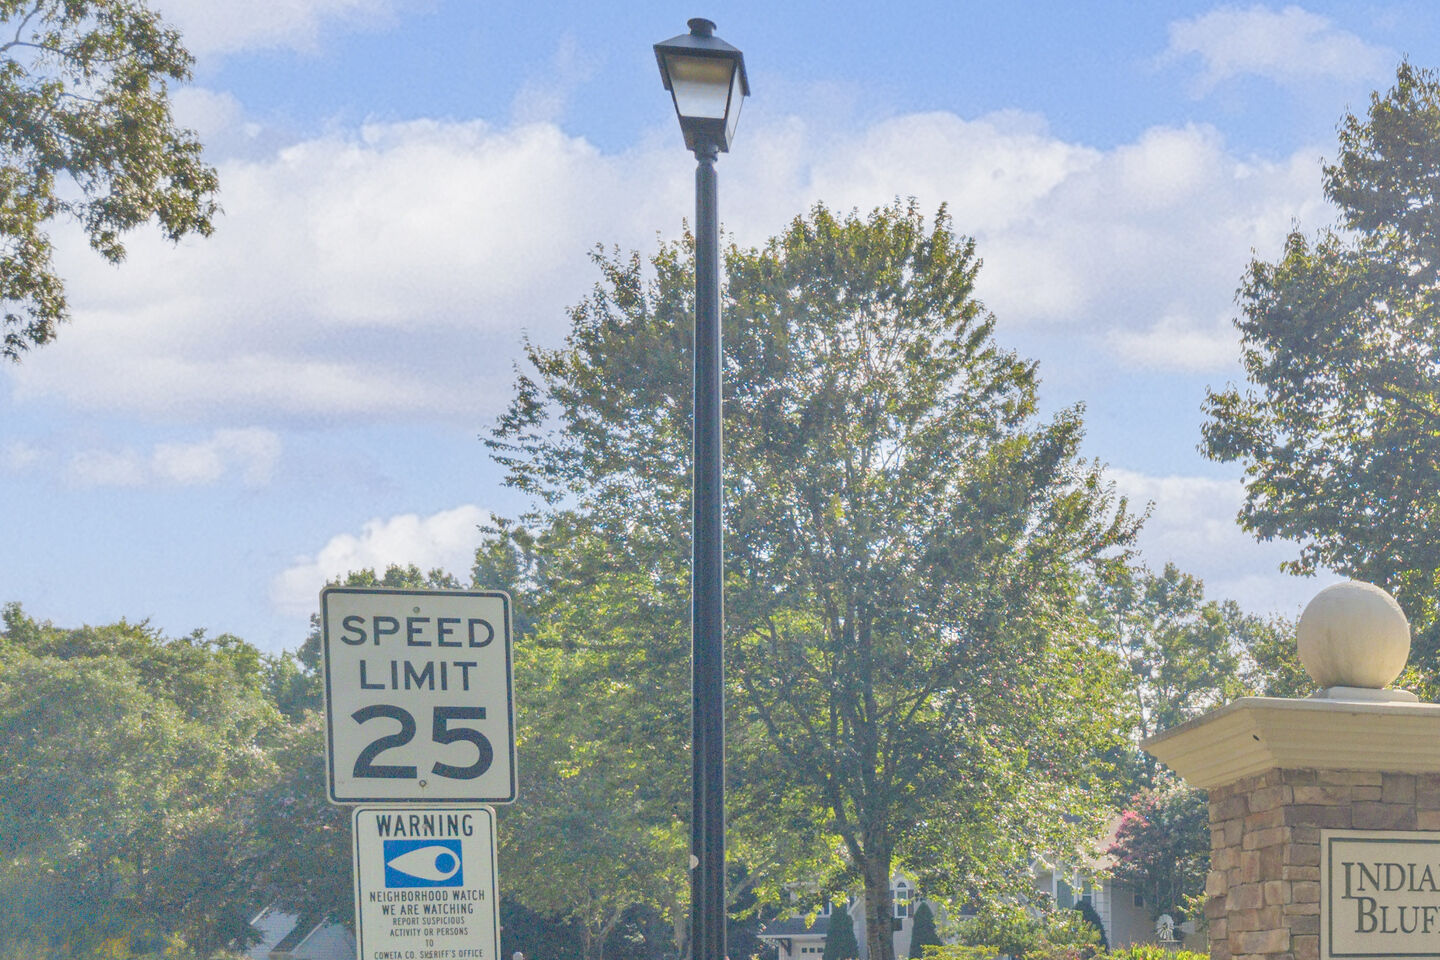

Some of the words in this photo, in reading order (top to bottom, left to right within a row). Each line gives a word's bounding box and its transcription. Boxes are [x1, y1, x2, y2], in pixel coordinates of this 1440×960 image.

[340, 615, 495, 648] SPEED
[359, 659, 478, 691] LIMIT
[350, 704, 494, 780] 25
[376, 814, 474, 837] WARNING
[369, 890, 449, 902] NEIGHBORHOOD
[452, 889, 485, 901] WATCH
[382, 904, 399, 915] WE
[400, 904, 419, 915] ARE
[423, 903, 474, 915] WATCHING
[392, 917, 419, 926] REPORT
[422, 916, 465, 925] SUSPICIOUS
[390, 928, 421, 937] ACTIVITY
[424, 928, 434, 936] OR
[436, 927, 469, 936] PERSONS
[425, 939, 434, 947] TO
[374, 951, 402, 960] COWETA
[405, 951, 417, 959] CO.
[419, 950, 456, 959] SHERIFF'S
[458, 949, 484, 957] OFFICE
